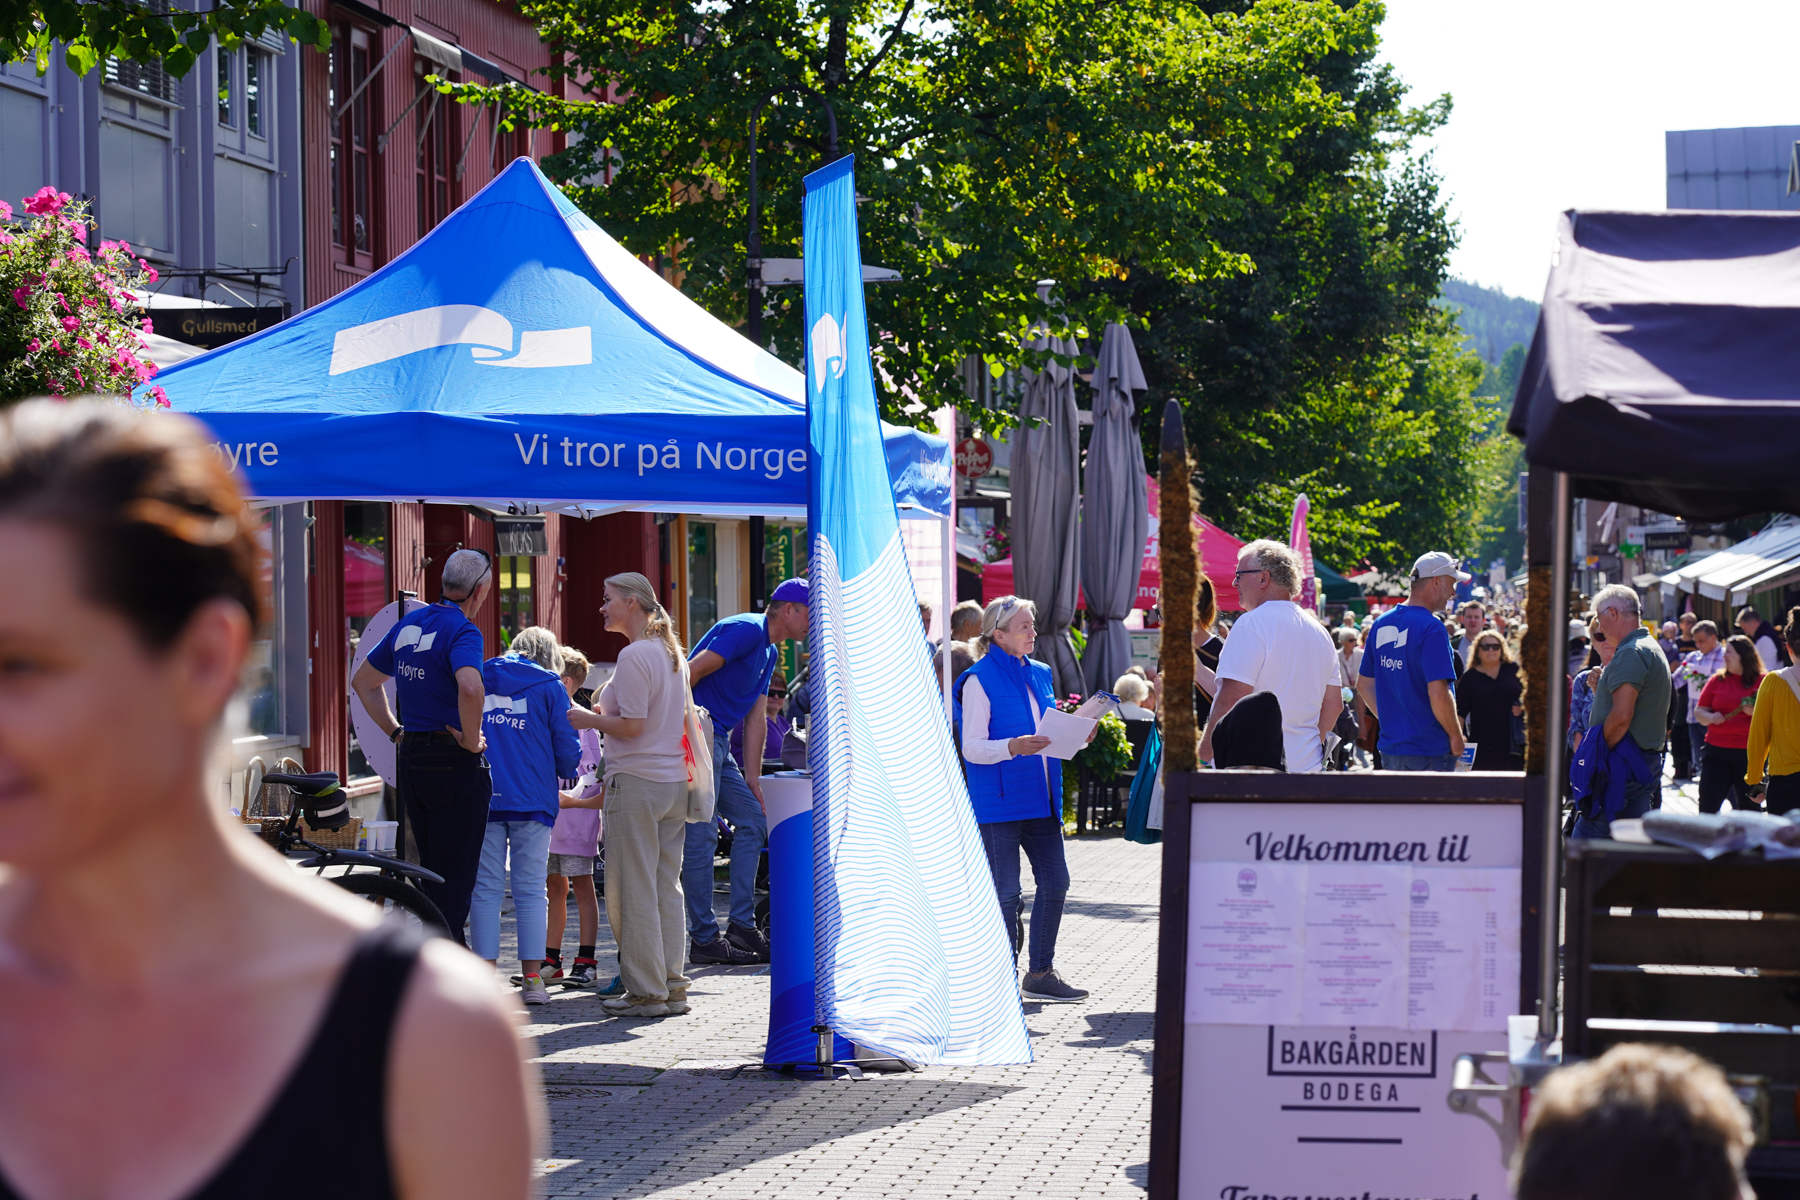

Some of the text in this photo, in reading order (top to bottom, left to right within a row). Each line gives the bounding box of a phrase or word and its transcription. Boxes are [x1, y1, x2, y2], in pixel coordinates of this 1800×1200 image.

[182, 319, 257, 337] Gullsmed
[206, 441, 279, 474] øyre
[514, 433, 807, 480] Vi tror på Norge
[397, 660, 425, 682] Høyre
[1380, 655, 1403, 671] Høyre
[487, 714, 526, 730] HØYRE
[1246, 831, 1472, 862] Velkommen til
[1281, 1033, 1426, 1067] BAKGÅRDEN
[1303, 1082, 1399, 1102] BODEGA
